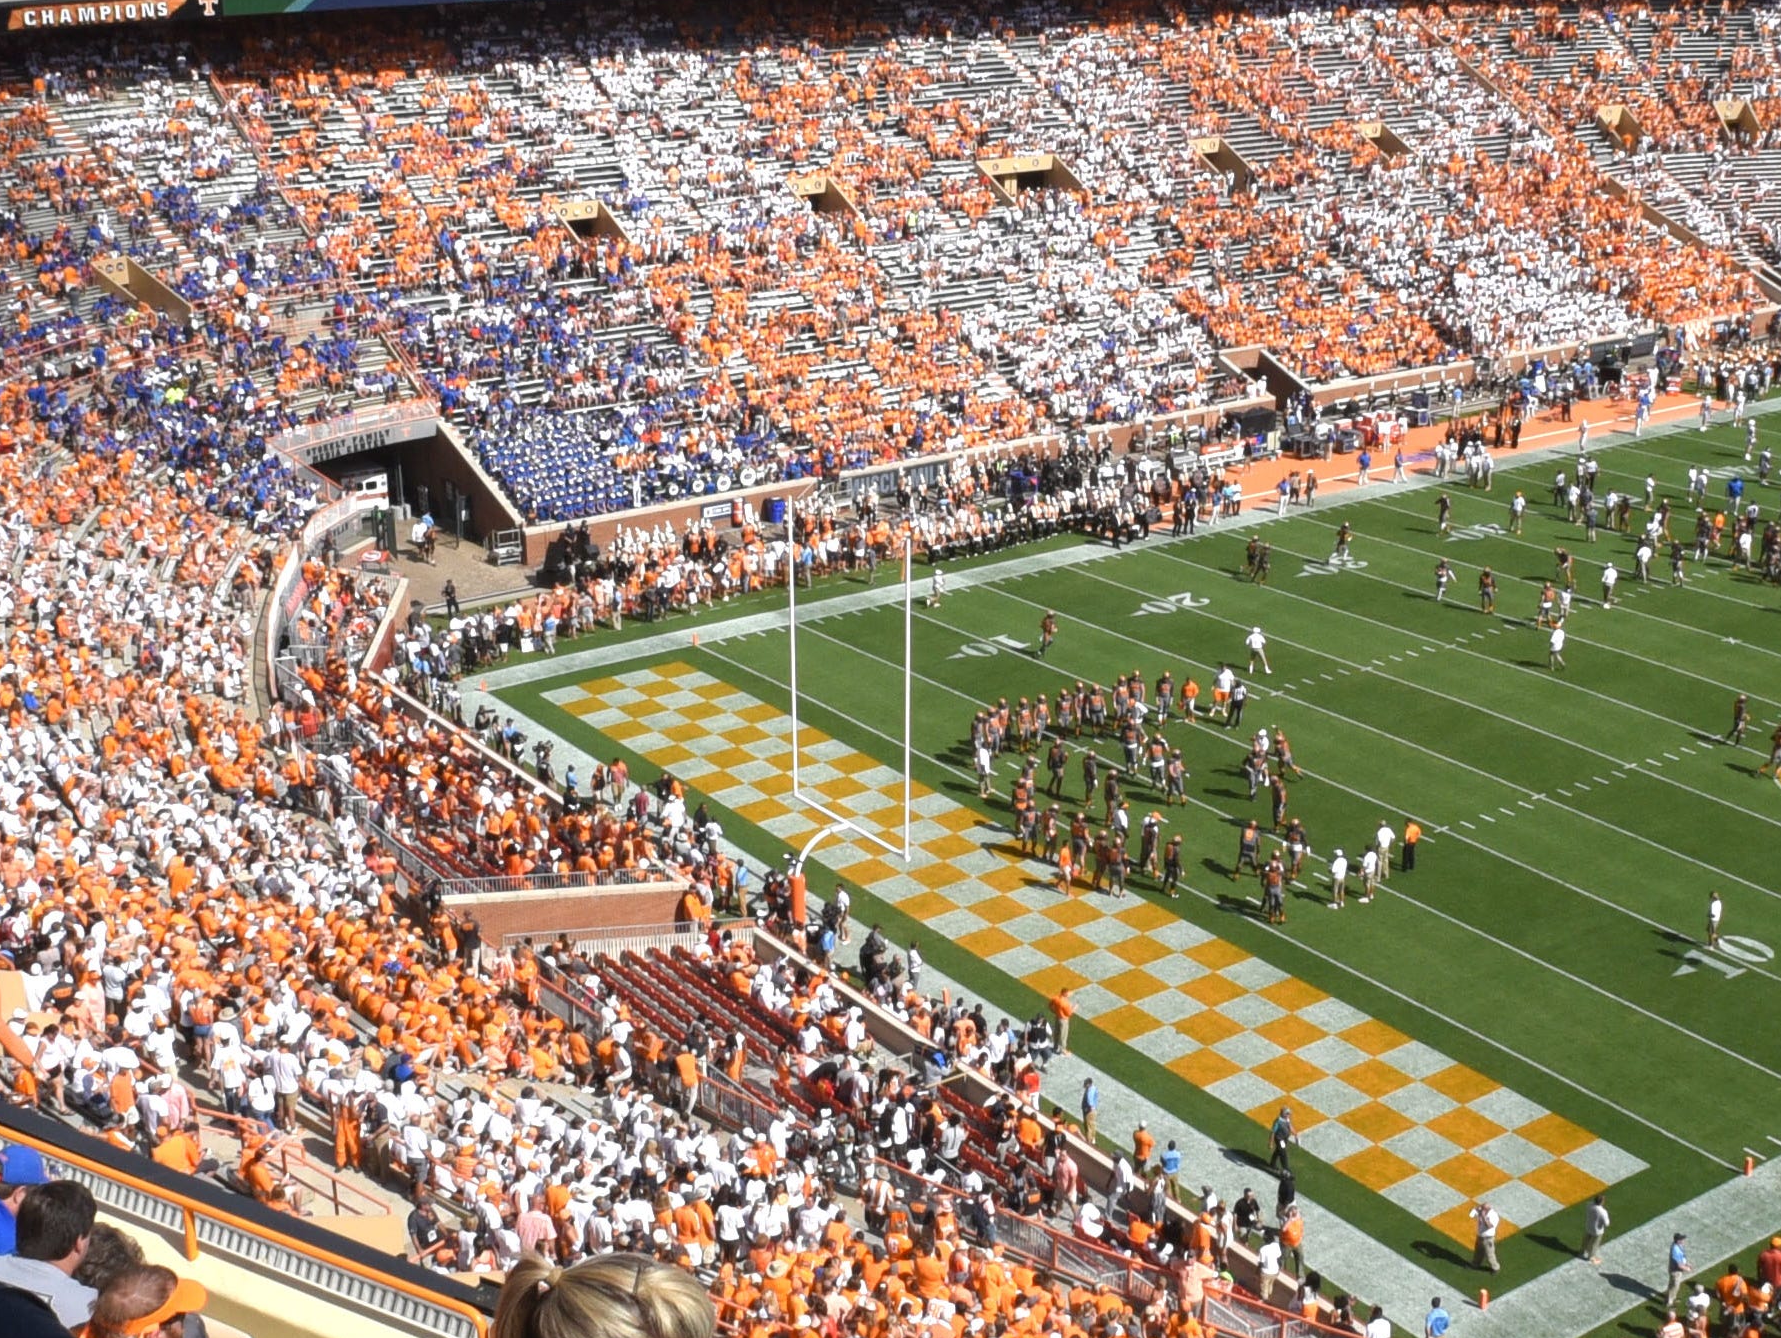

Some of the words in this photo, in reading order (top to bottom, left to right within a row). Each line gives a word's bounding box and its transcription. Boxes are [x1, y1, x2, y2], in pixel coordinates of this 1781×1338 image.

[23, 0, 169, 27] CHAMPIONS
[352, 428, 391, 445] FAMILY
[312, 449, 340, 464] MEDIA
[346, 438, 387, 454] CENTER
[1140, 591, 1211, 616] 20
[960, 634, 1032, 658] 10
[1683, 935, 1775, 980] 10
